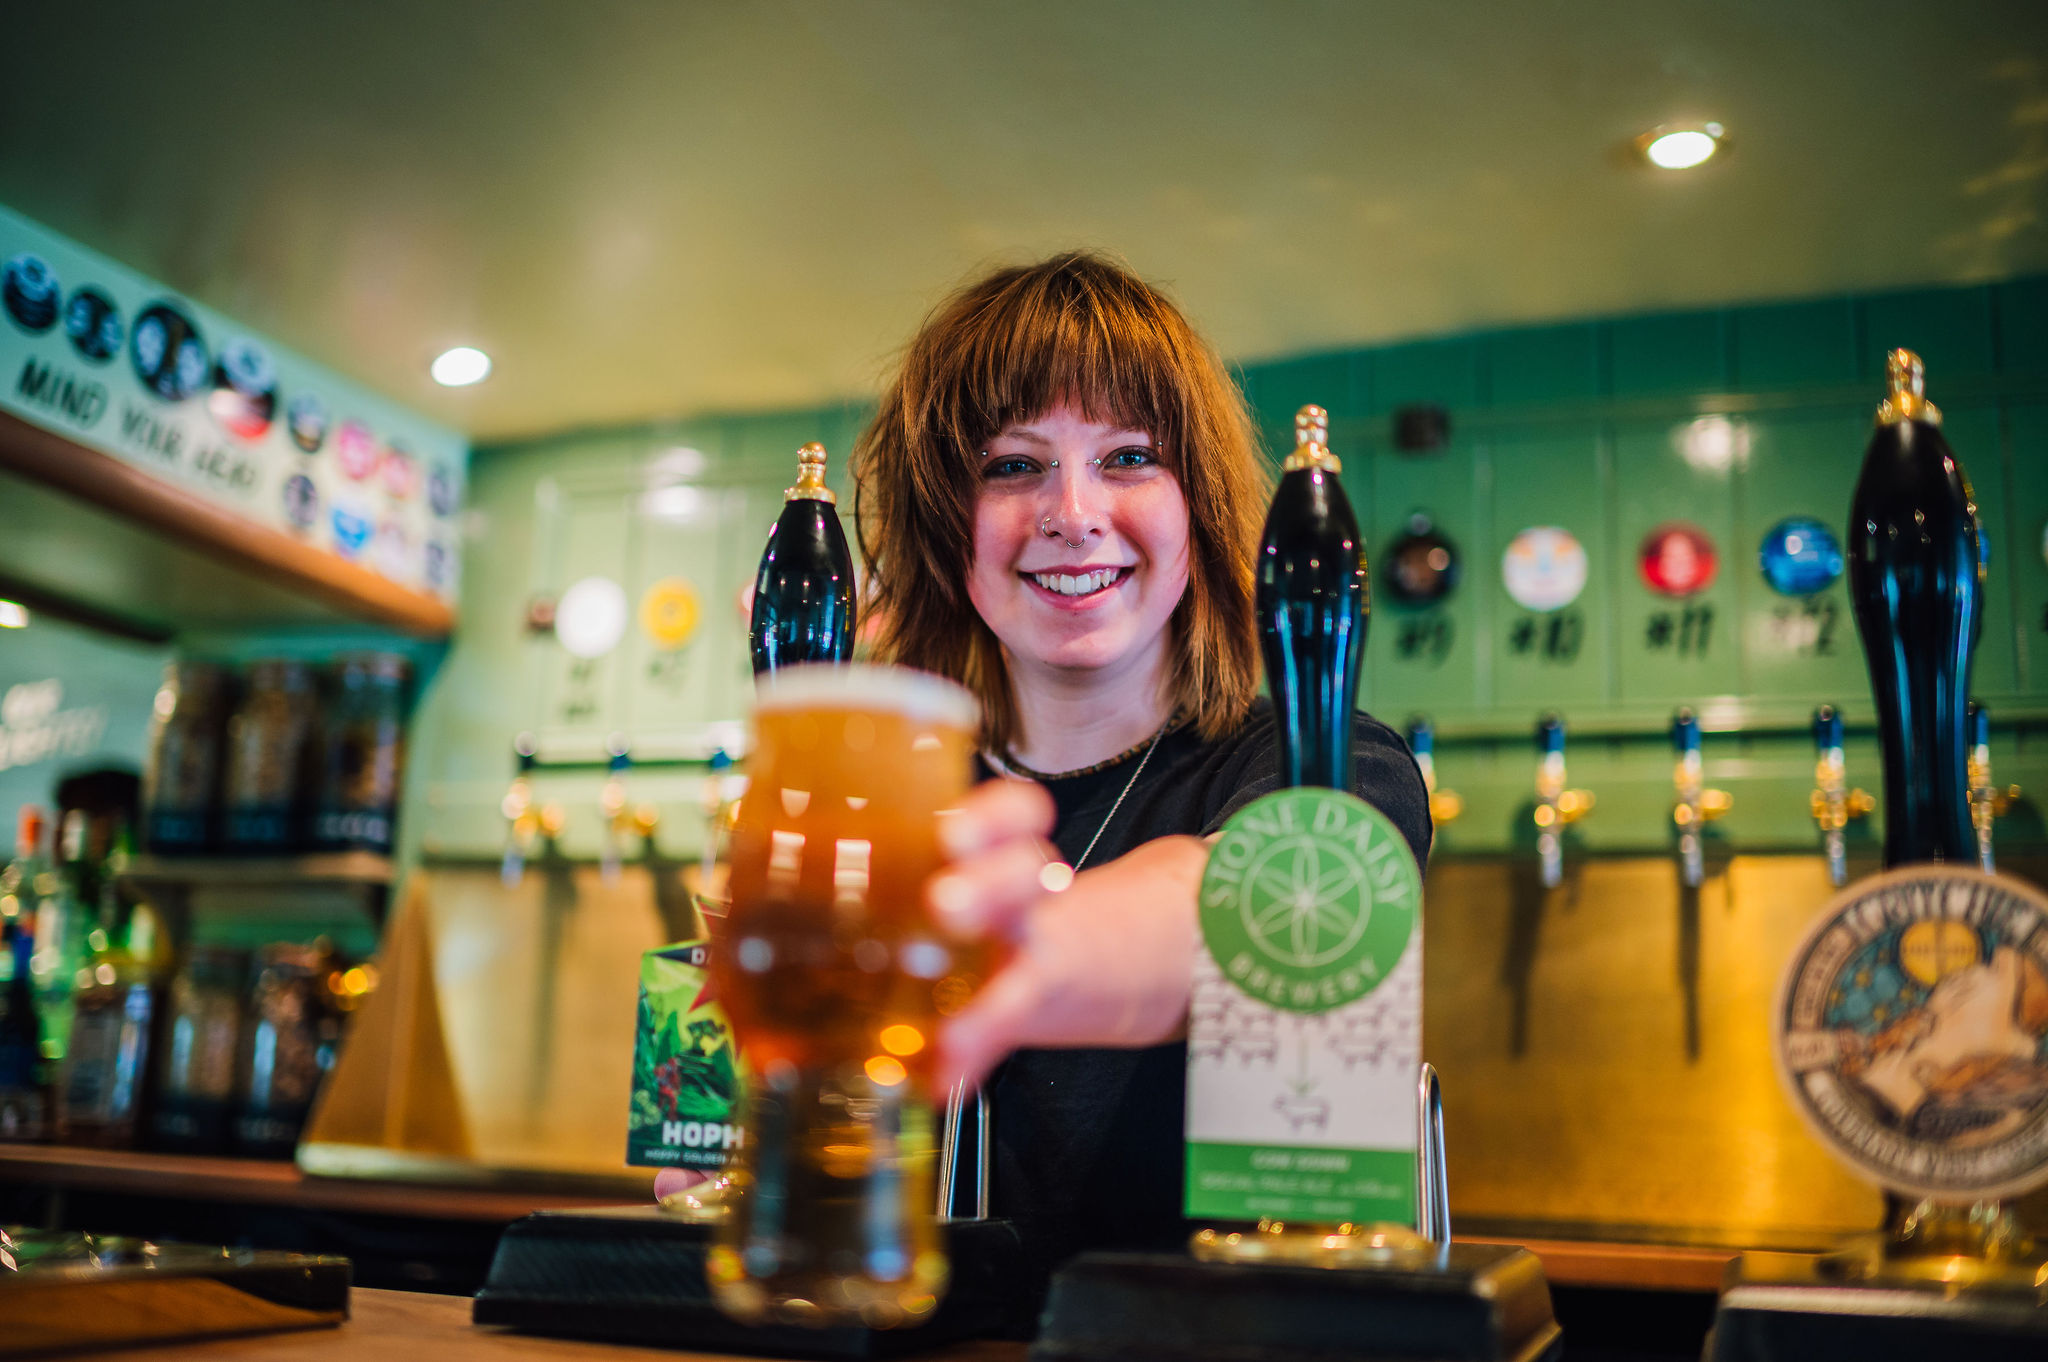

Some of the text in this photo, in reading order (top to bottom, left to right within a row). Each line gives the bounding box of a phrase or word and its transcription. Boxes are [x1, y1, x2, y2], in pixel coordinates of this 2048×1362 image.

[19, 356, 108, 428] MIND
[1510, 606, 1585, 668] #10
[1645, 603, 1714, 659] #11
[1203, 798, 1411, 910] STONE DAISY
[1228, 952, 1379, 1007] BREWERY
